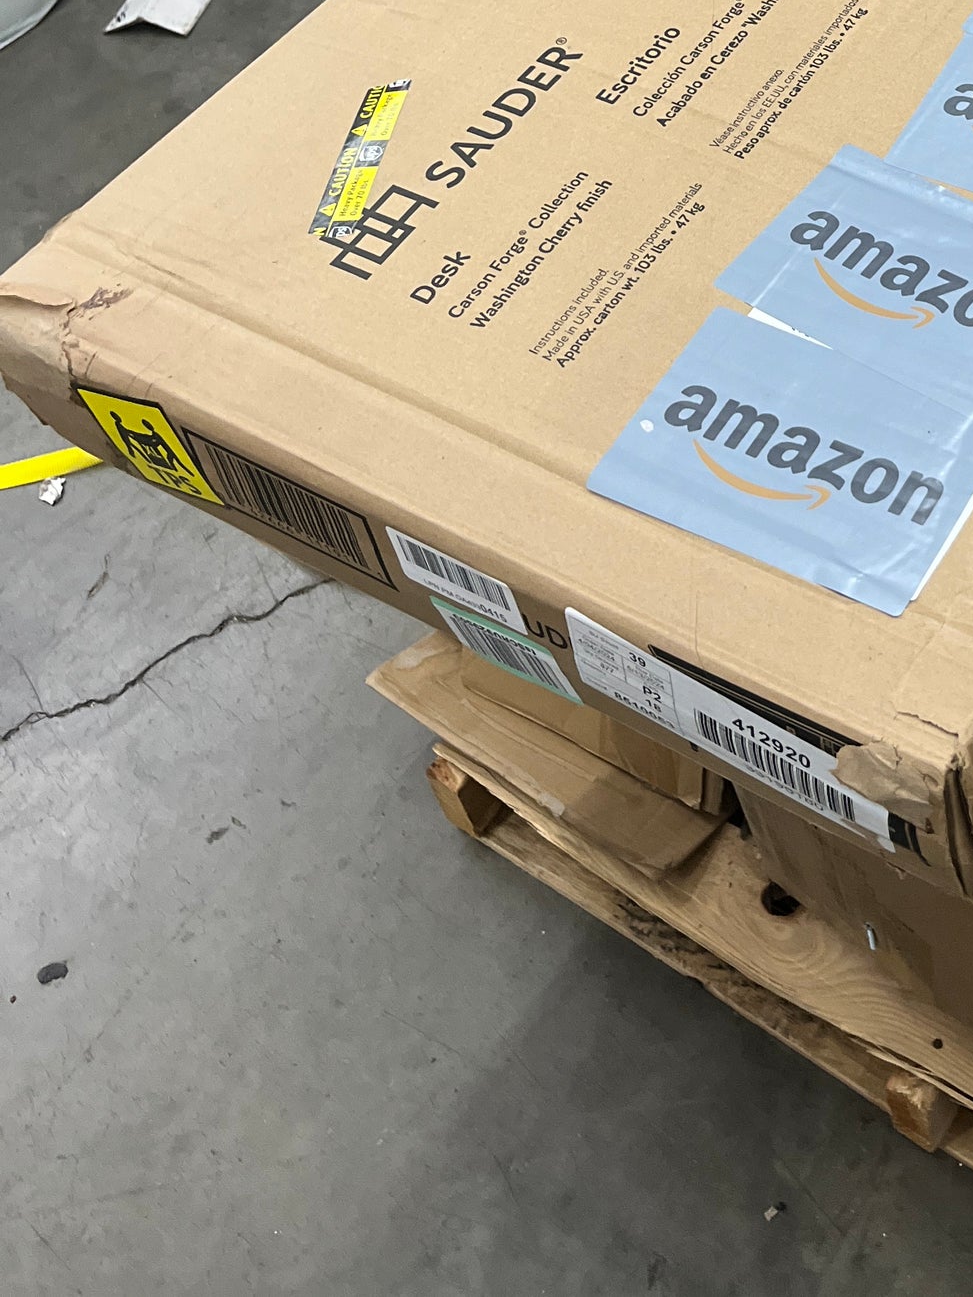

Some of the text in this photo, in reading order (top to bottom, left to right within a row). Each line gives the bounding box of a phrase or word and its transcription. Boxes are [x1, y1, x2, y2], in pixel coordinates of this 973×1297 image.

[596, 27, 680, 105] Escritorio
[632, 66, 686, 117] Colección
[680, 29, 720, 65] Carson
[656, 79, 703, 127] Acabado
[700, 65, 717, 80] en
[710, 30, 748, 65] Cerezo
[784, 70, 799, 84] con
[796, 35, 828, 71] materiales
[709, 69, 785, 148] Véase instructivo anexo.
[734, 7, 869, 160] Peso aprox. de cartón 103 lbs. 47 kg
[746, 120, 757, 132] en
[751, 109, 767, 120] los
[723, 131, 749, 154] Hecho
[328, 147, 358, 197] CAUTION
[339, 197, 351, 217] Heavy
[347, 169, 363, 198] Package
[350, 198, 361, 216] Over
[357, 189, 366, 200] 70
[448, 270, 496, 319] Carson
[528, 170, 589, 229] Collection
[470, 179, 613, 329] Washington Cherry finish
[410, 251, 471, 305] Desk
[542, 335, 569, 362] Made
[565, 325, 578, 336] in
[573, 305, 596, 326] USA
[593, 286, 612, 305] with
[623, 252, 640, 270] and
[636, 216, 671, 254] imported
[668, 182, 703, 219] materials
[556, 202, 705, 368] Approx. carton wt. 103 lbs. 47 kg
[529, 268, 610, 355] Instructions included.
[147, 464, 202, 495] TPS
[664, 385, 945, 526] amazon
[629, 651, 646, 667] 39
[643, 685, 663, 703] P2
[732, 718, 811, 769] 412920
